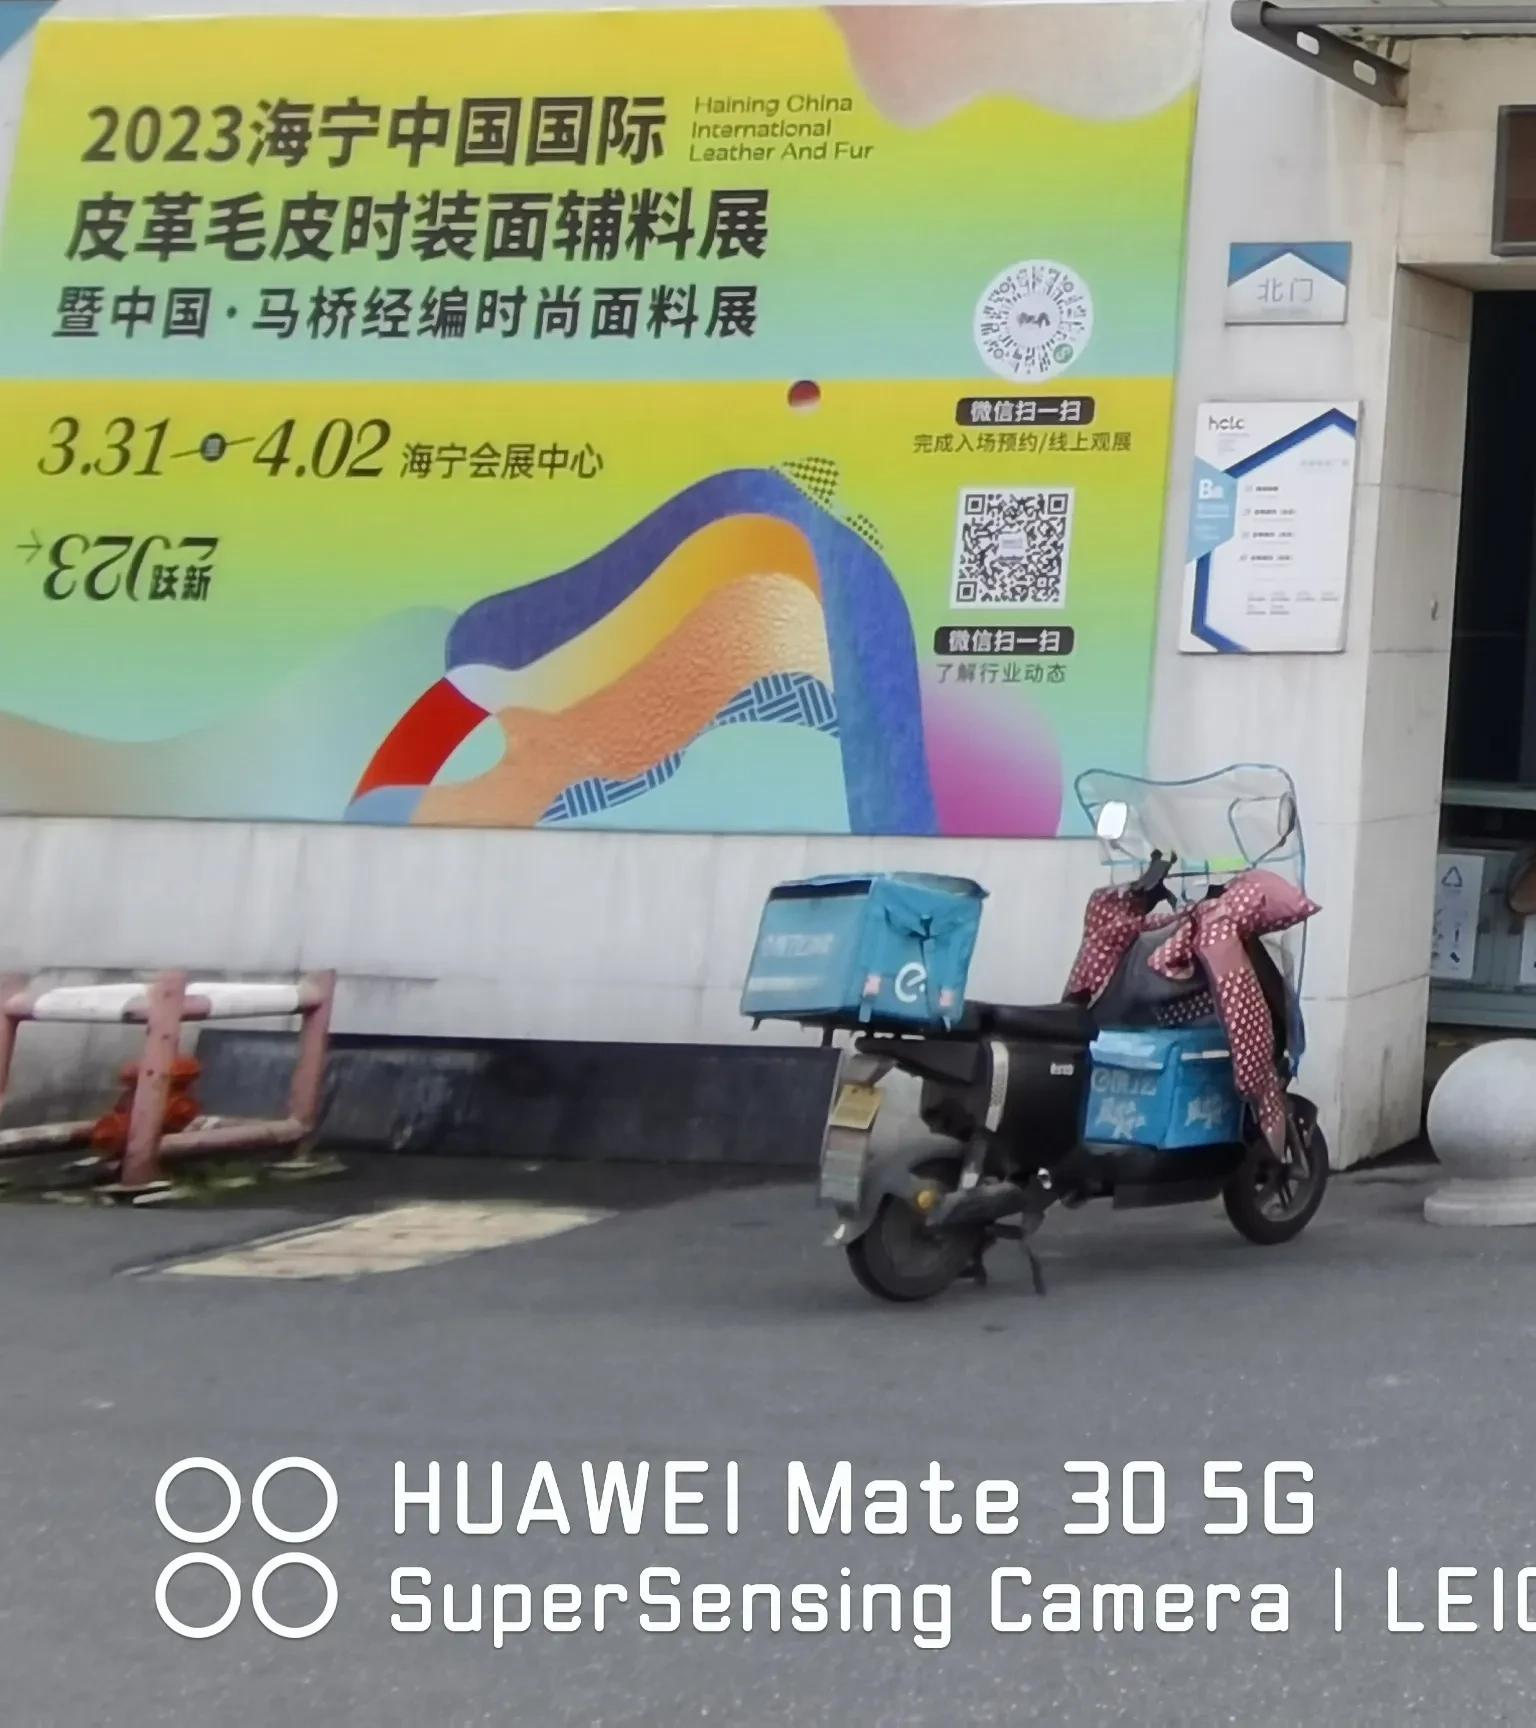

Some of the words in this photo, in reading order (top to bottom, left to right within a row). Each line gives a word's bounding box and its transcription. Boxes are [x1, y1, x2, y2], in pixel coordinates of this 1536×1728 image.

[694, 96, 780, 116] Haining
[786, 94, 853, 112] China
[81, 94, 667, 168] 2023海宁中国国际
[691, 119, 832, 139] International
[689, 144, 775, 162] Leather
[780, 142, 827, 160] And
[834, 141, 874, 159] Fur
[65, 186, 770, 262] 皮革毛皮时装面辅料展
[1257, 277, 1314, 303] 北门
[52, 282, 759, 341] 暨中国·马桥经编时尚面料展
[970, 399, 1082, 422] 微信扫一扫
[38, 416, 170, 477] 3.31
[252, 418, 391, 478] 4.02
[400, 441, 605, 480] 海宁会展中心
[912, 431, 1133, 454] 完成入场预约/线上观展
[148, 564, 214, 601] 跃新
[948, 629, 1061, 652] 微信扫一扫
[936, 662, 1067, 684] 了解行业动态
